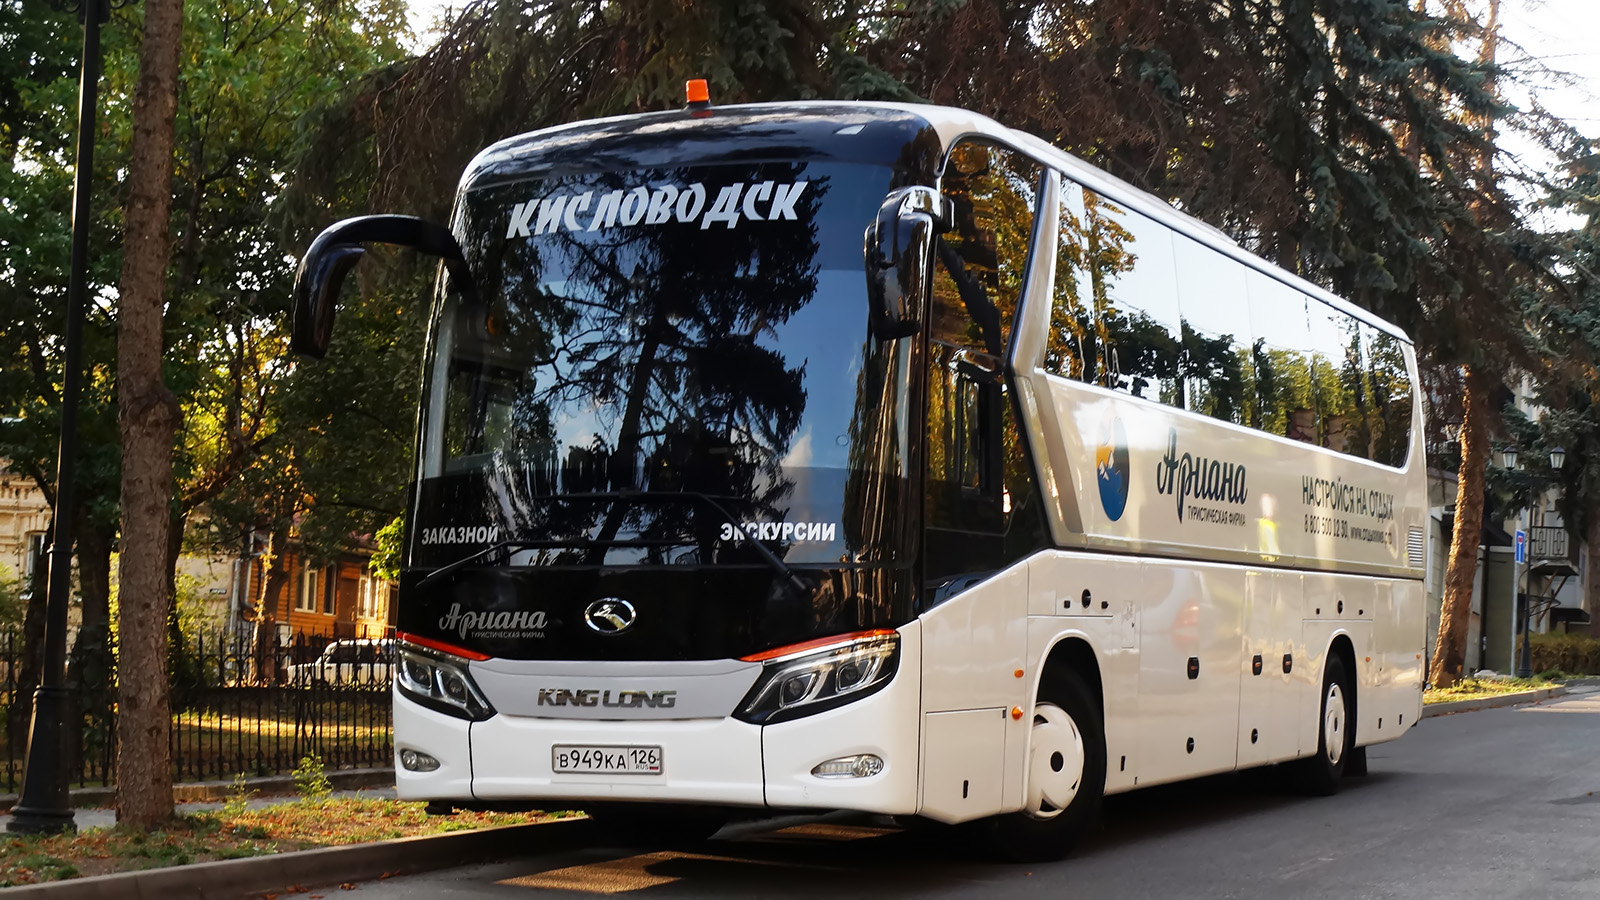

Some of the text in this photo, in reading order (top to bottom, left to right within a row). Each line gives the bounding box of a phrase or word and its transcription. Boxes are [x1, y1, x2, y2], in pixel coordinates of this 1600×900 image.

[505, 180, 808, 239] КИСЛОВОДСК
[1156, 427, 1248, 524] Ариана
[1302, 475, 1394, 524] НАСТРОЙСЯ НА ОТДЫХ
[421, 523, 498, 545] ЗАКАЗНОЙ
[720, 522, 836, 541] ЭКСКУРСИИ
[439, 602, 548, 640] Ариана
[471, 631, 546, 639] ТУРИСТИЧЕСКАЯ ФИРМА
[537, 688, 677, 708] KING LONG
[630, 749, 657, 764] 126
